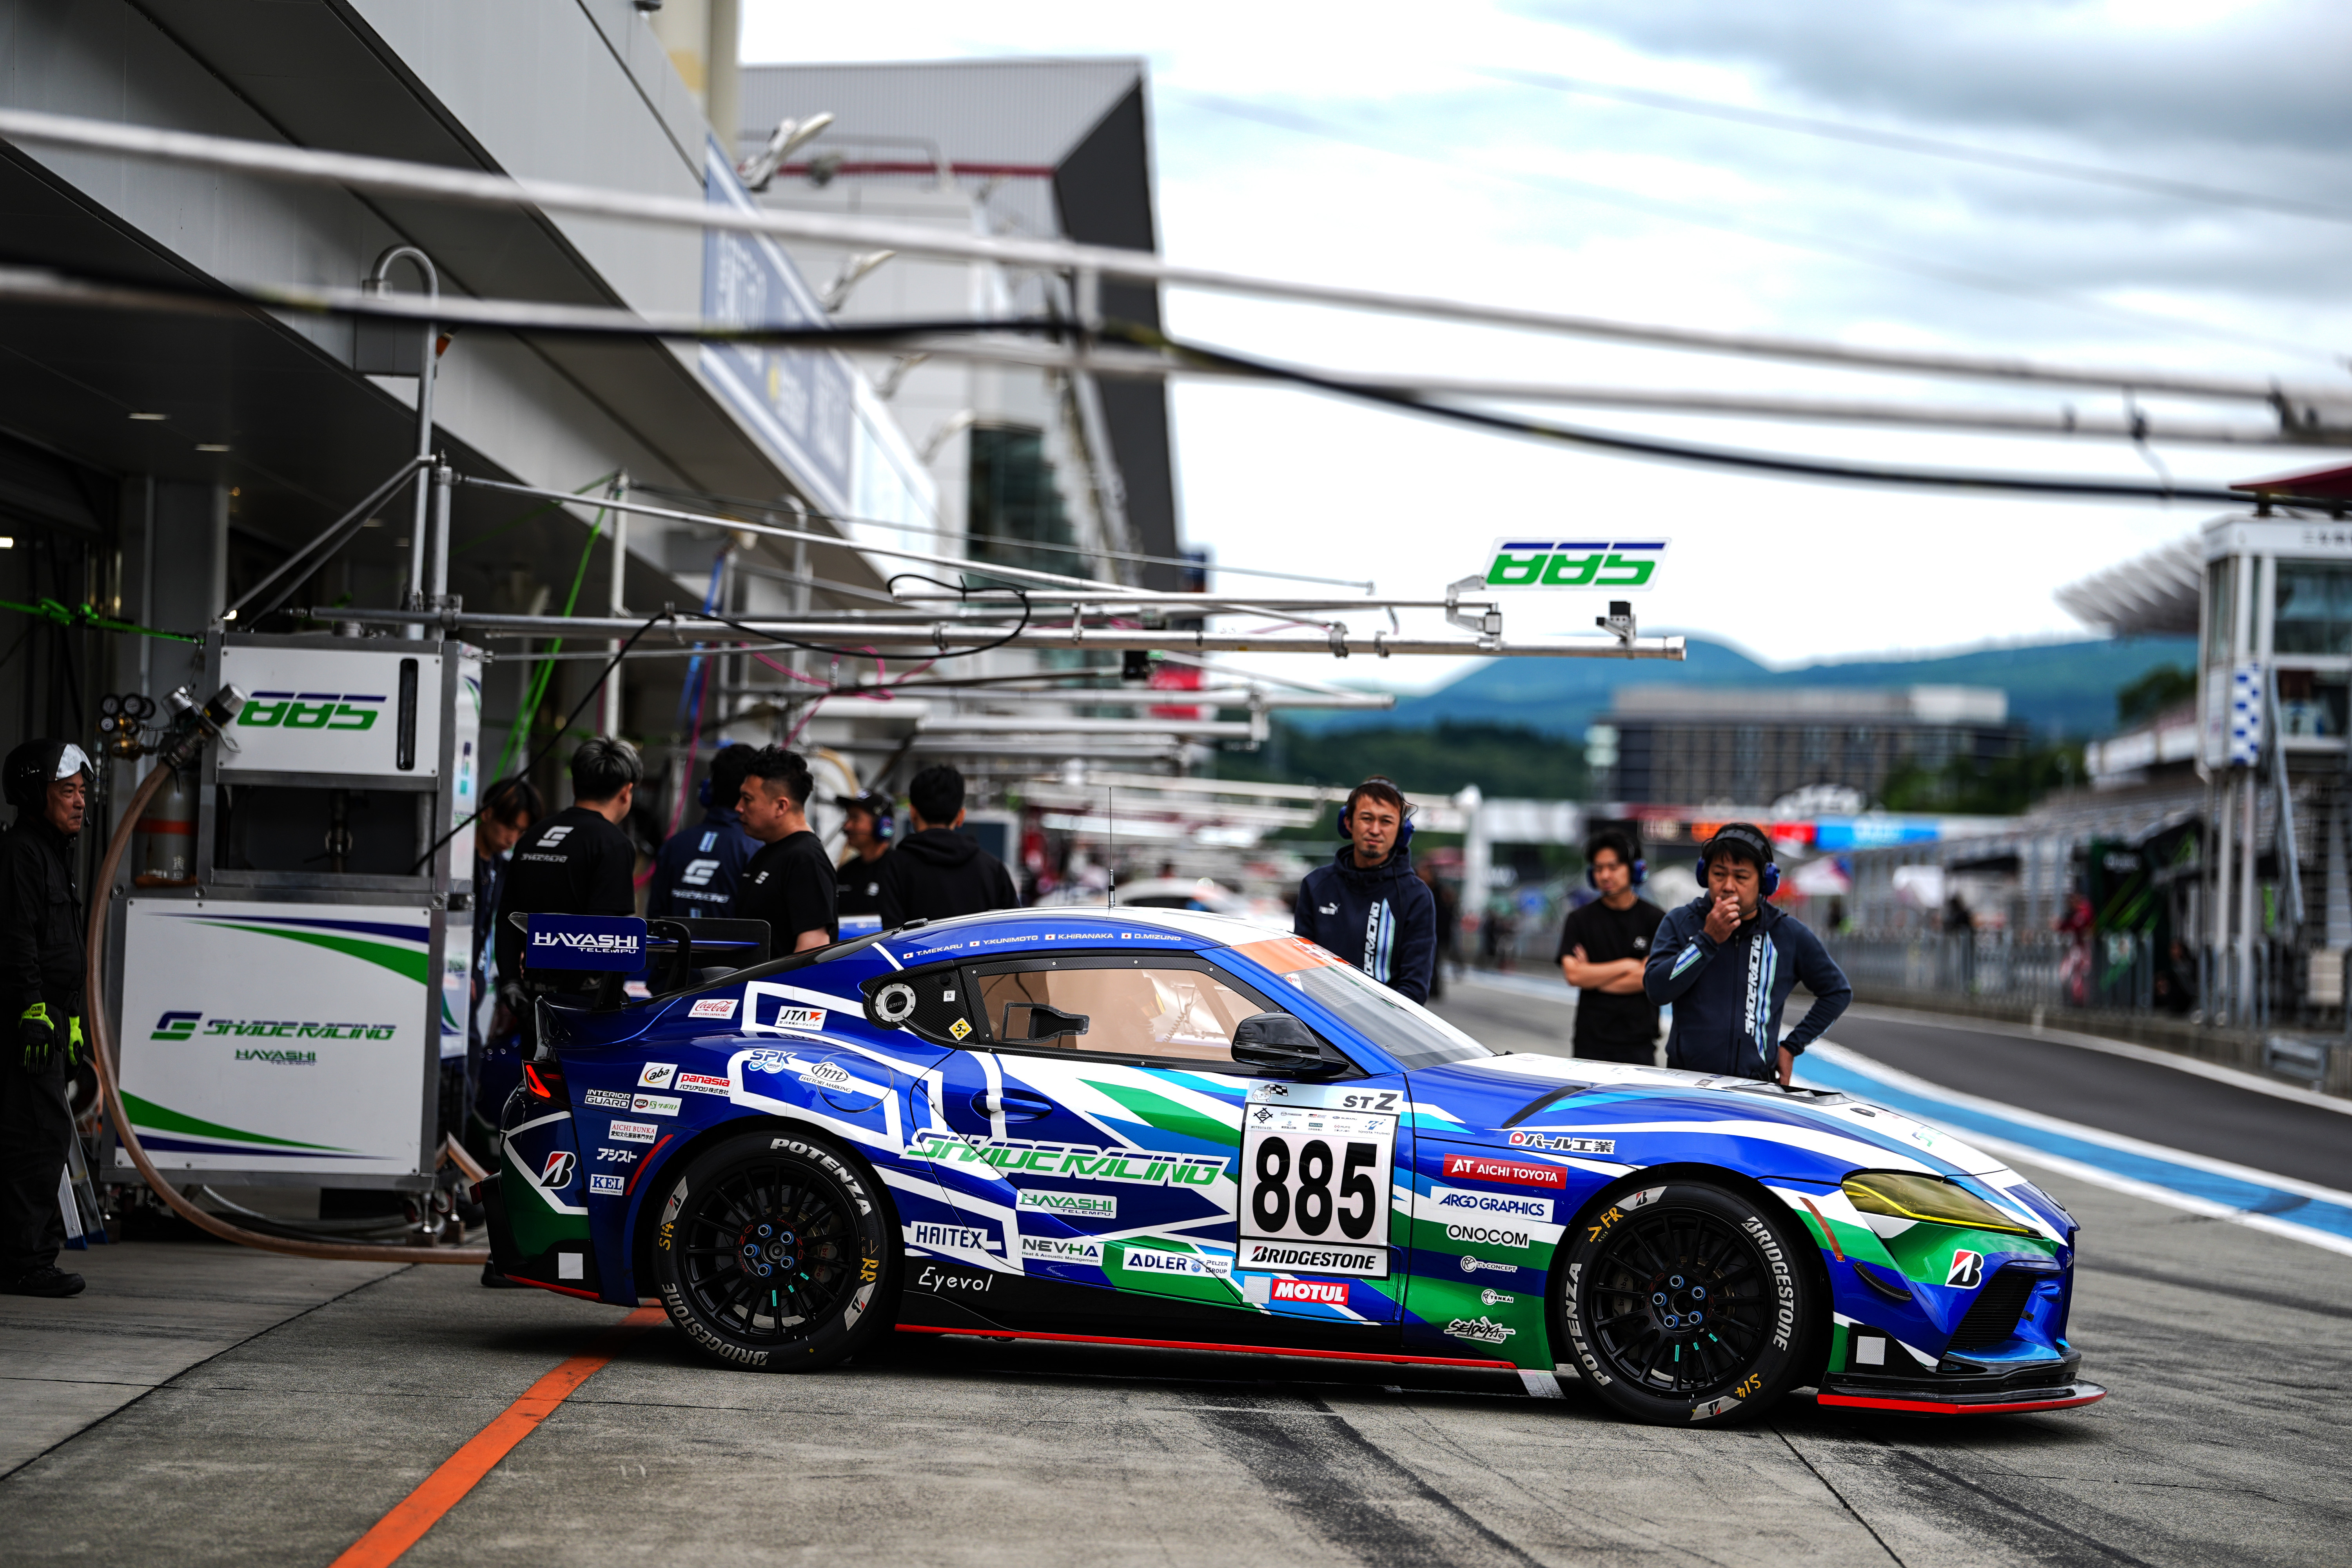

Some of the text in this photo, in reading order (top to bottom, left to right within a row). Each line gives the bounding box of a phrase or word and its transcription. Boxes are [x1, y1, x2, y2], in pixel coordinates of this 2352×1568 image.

[1486, 543, 1666, 586] 885
[237, 690, 387, 731] 885
[534, 932, 639, 948] HAYASHI
[982, 935, 1038, 945] Y.KUNIMOTO
[1134, 933, 1181, 942] D.MIZUNO
[916, 943, 963, 956] T.MEKARU
[781, 1010, 808, 1021] JTA
[234, 1049, 317, 1061] HAYASHI
[749, 1050, 793, 1065] SPK
[649, 1067, 671, 1081] aba
[680, 1074, 731, 1087] panasia
[800, 1076, 851, 1093] HATTORI MARKING
[586, 1096, 629, 1108] GUARD
[587, 1089, 631, 1100] INTERIOR
[1528, 1134, 1614, 1153] パール工業
[597, 1148, 637, 1163] アシスト
[1059, 1148, 1223, 1186] RACING
[1451, 1159, 1558, 1183] AT AICHI TOYOTA
[592, 1176, 622, 1190] KEL
[770, 1138, 873, 1216] POTENZA
[1252, 1136, 1378, 1240] 885
[1020, 1193, 1114, 1212] HAYASHI
[1438, 1193, 1544, 1216] ARGO GRAPHICS
[916, 1225, 982, 1249] HAITEX
[1448, 1225, 1528, 1246] ONOCOM
[1022, 1238, 1099, 1258] NEVHA
[1127, 1253, 1187, 1271] ADLER
[1250, 1246, 1376, 1270] BRIDGESTONE
[1486, 1263, 1517, 1272] CONCEPT
[918, 1267, 994, 1292] Eyevol
[1742, 1216, 1795, 1352] BRIDGESTONE
[1274, 1282, 1346, 1301] MOTUL
[661, 1283, 770, 1366] BRIDGESTONE
[1565, 1263, 1613, 1387] POTENZA
